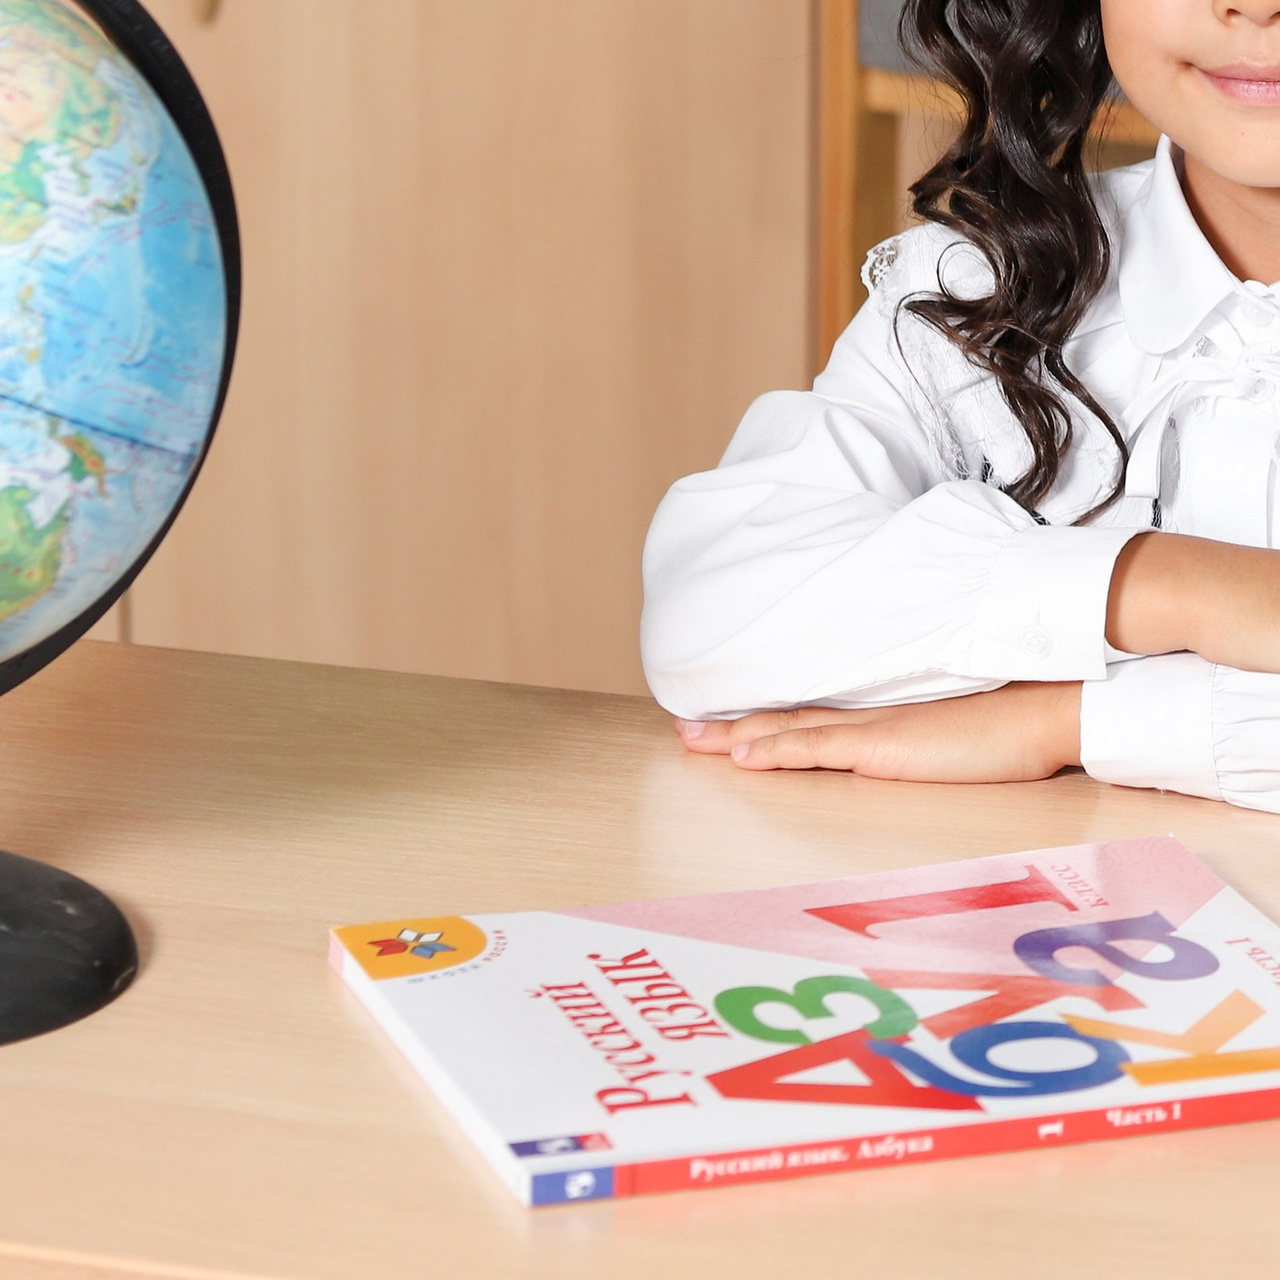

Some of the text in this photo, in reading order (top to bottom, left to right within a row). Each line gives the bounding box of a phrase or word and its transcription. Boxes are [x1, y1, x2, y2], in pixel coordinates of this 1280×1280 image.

[803, 864, 1078, 939] 1
[1050, 863, 1109, 909] класс
[523, 981, 698, 1115] Русский
[1106, 1102, 1182, 1127] Часть 1
[689, 1150, 785, 1182] Русский
[856, 1135, 933, 1160] Азбука
